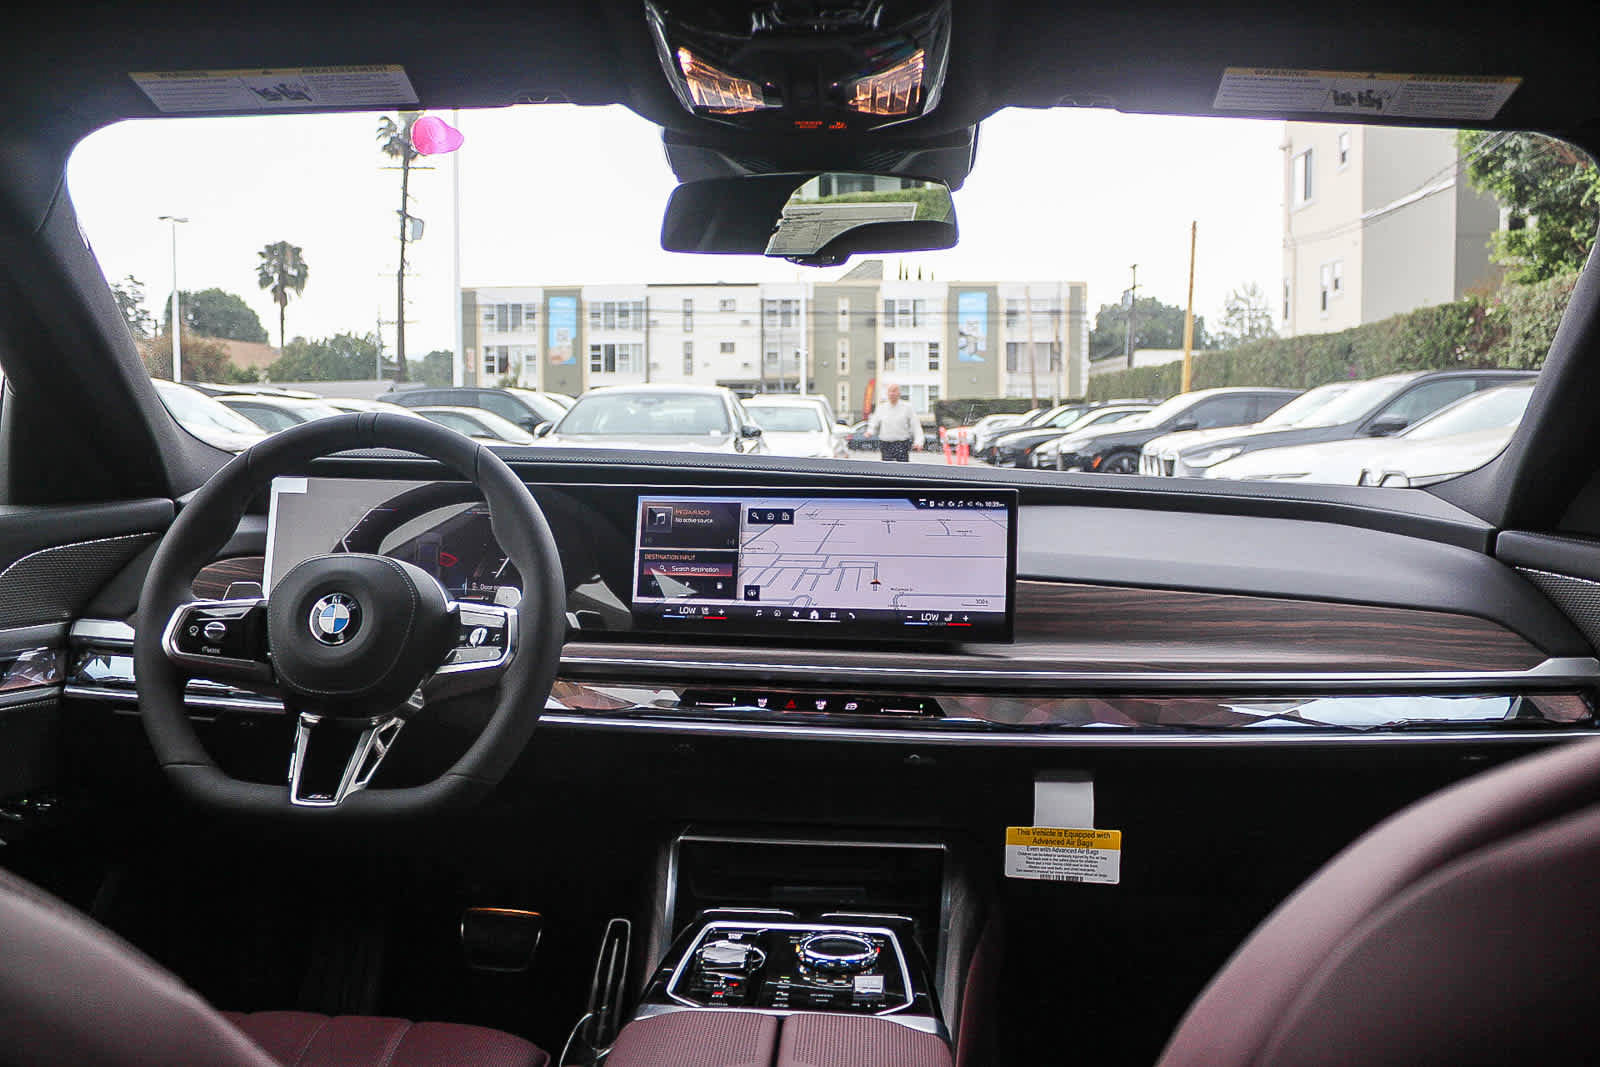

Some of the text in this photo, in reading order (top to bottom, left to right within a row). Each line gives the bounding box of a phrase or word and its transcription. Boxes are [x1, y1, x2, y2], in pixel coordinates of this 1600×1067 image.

[679, 606, 696, 614] LOW
[921, 612, 939, 621] LOW
[1064, 830, 1096, 840] Equipped
[1096, 831, 1111, 839] with
[1032, 837, 1093, 848] Advanced Air Bags
